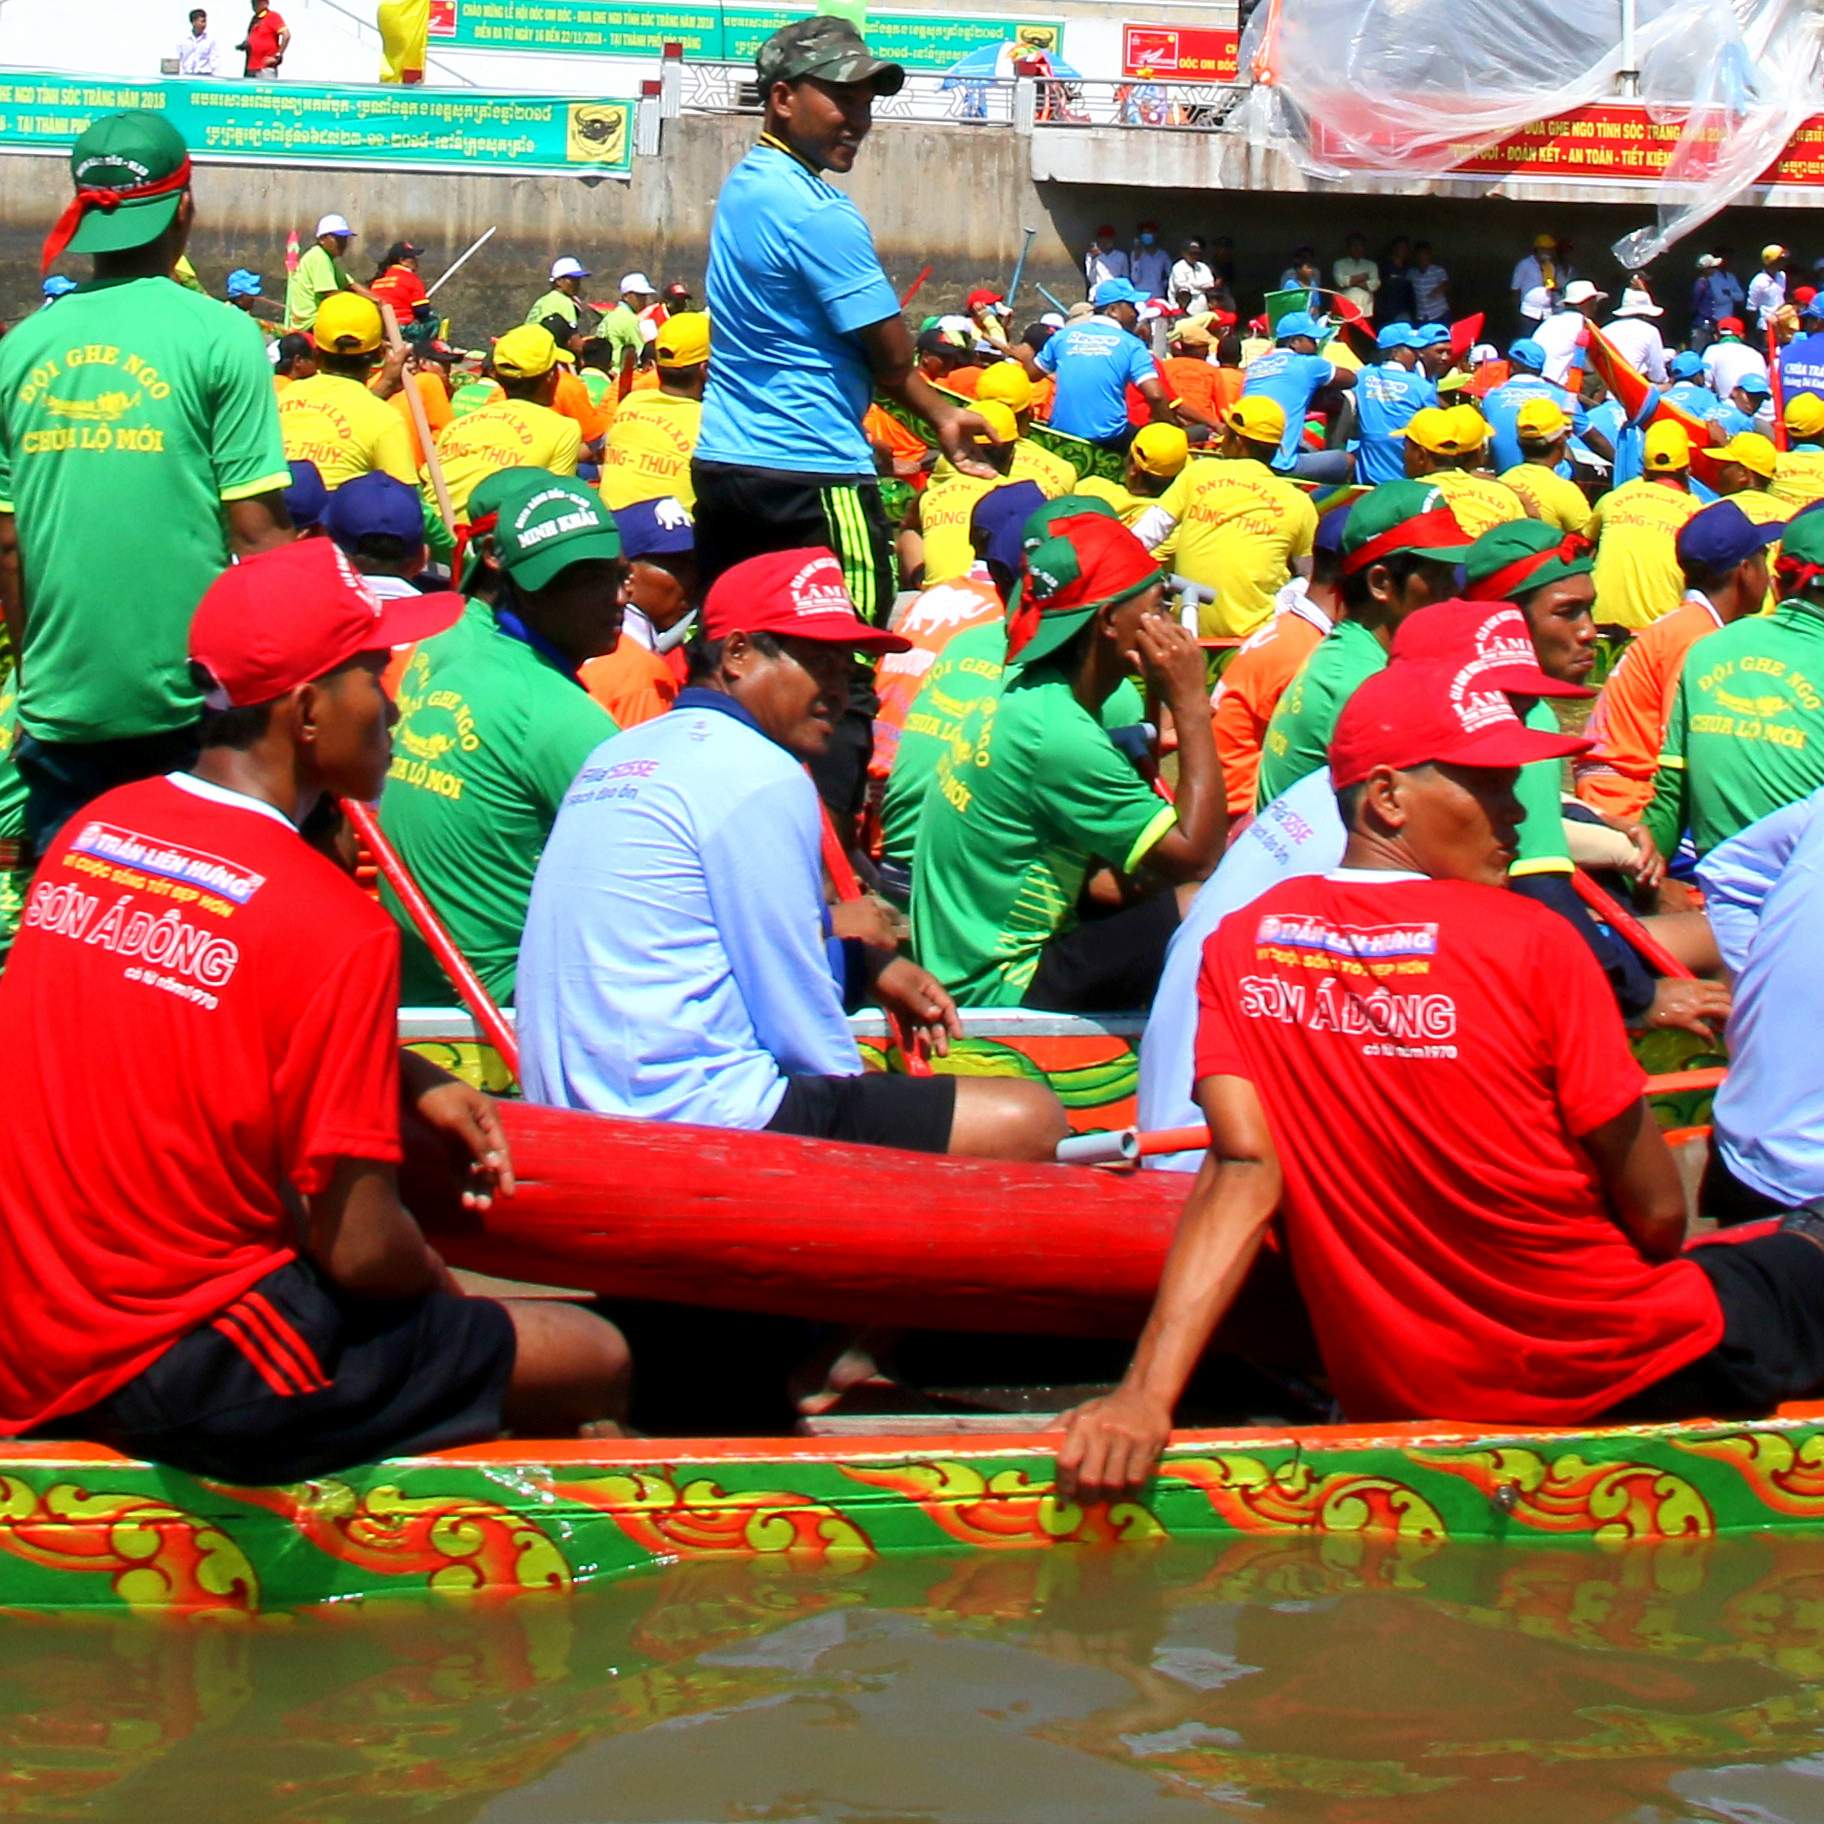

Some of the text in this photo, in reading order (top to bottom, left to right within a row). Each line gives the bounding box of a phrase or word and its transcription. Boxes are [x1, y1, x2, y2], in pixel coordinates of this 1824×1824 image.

[1549, 120, 1570, 136] GHE
[1572, 120, 1594, 138] NGO
[1623, 119, 1644, 140] SÓC
[1539, 143, 1561, 163] KẾT
[1568, 146, 1584, 164] AN
[1585, 145, 1614, 165] TOÀN
[65, 344, 120, 368] GHE
[122, 353, 171, 400] NGO
[22, 424, 77, 454] CHÙA
[80, 422, 113, 453] LỘ
[517, 520, 558, 548] MINH
[1739, 656, 1787, 678] GHE
[1785, 671, 1824, 710] NGO
[143, 844, 184, 874] LIÊN
[24, 880, 100, 940] SƠN
